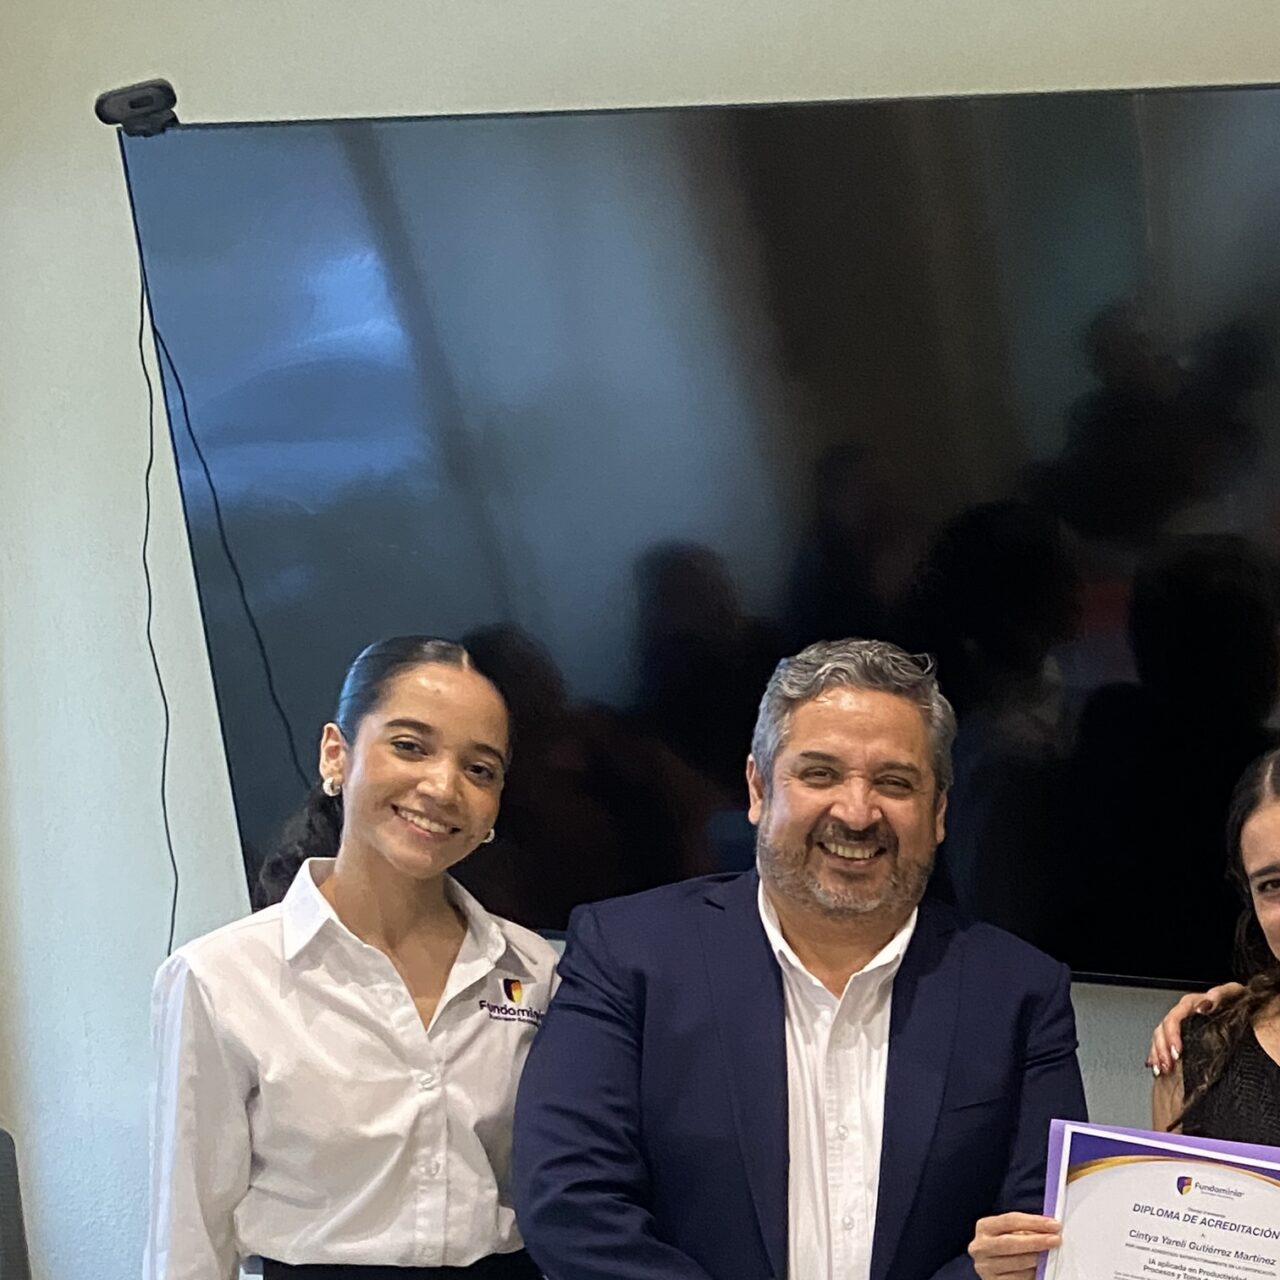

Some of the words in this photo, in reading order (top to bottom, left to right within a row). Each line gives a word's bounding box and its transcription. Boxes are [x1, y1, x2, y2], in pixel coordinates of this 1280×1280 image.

[1133, 1203, 1181, 1220] DIPLOMA
[1182, 1213, 1198, 1224] DE
[1200, 1217, 1280, 1239] ACREDITACIÓN
[1128, 1229, 1159, 1243] Cintya
[1161, 1236, 1187, 1248] Yareli
[1143, 1265, 1176, 1277] Procesos
[1157, 1260, 1187, 1271] aplicada
